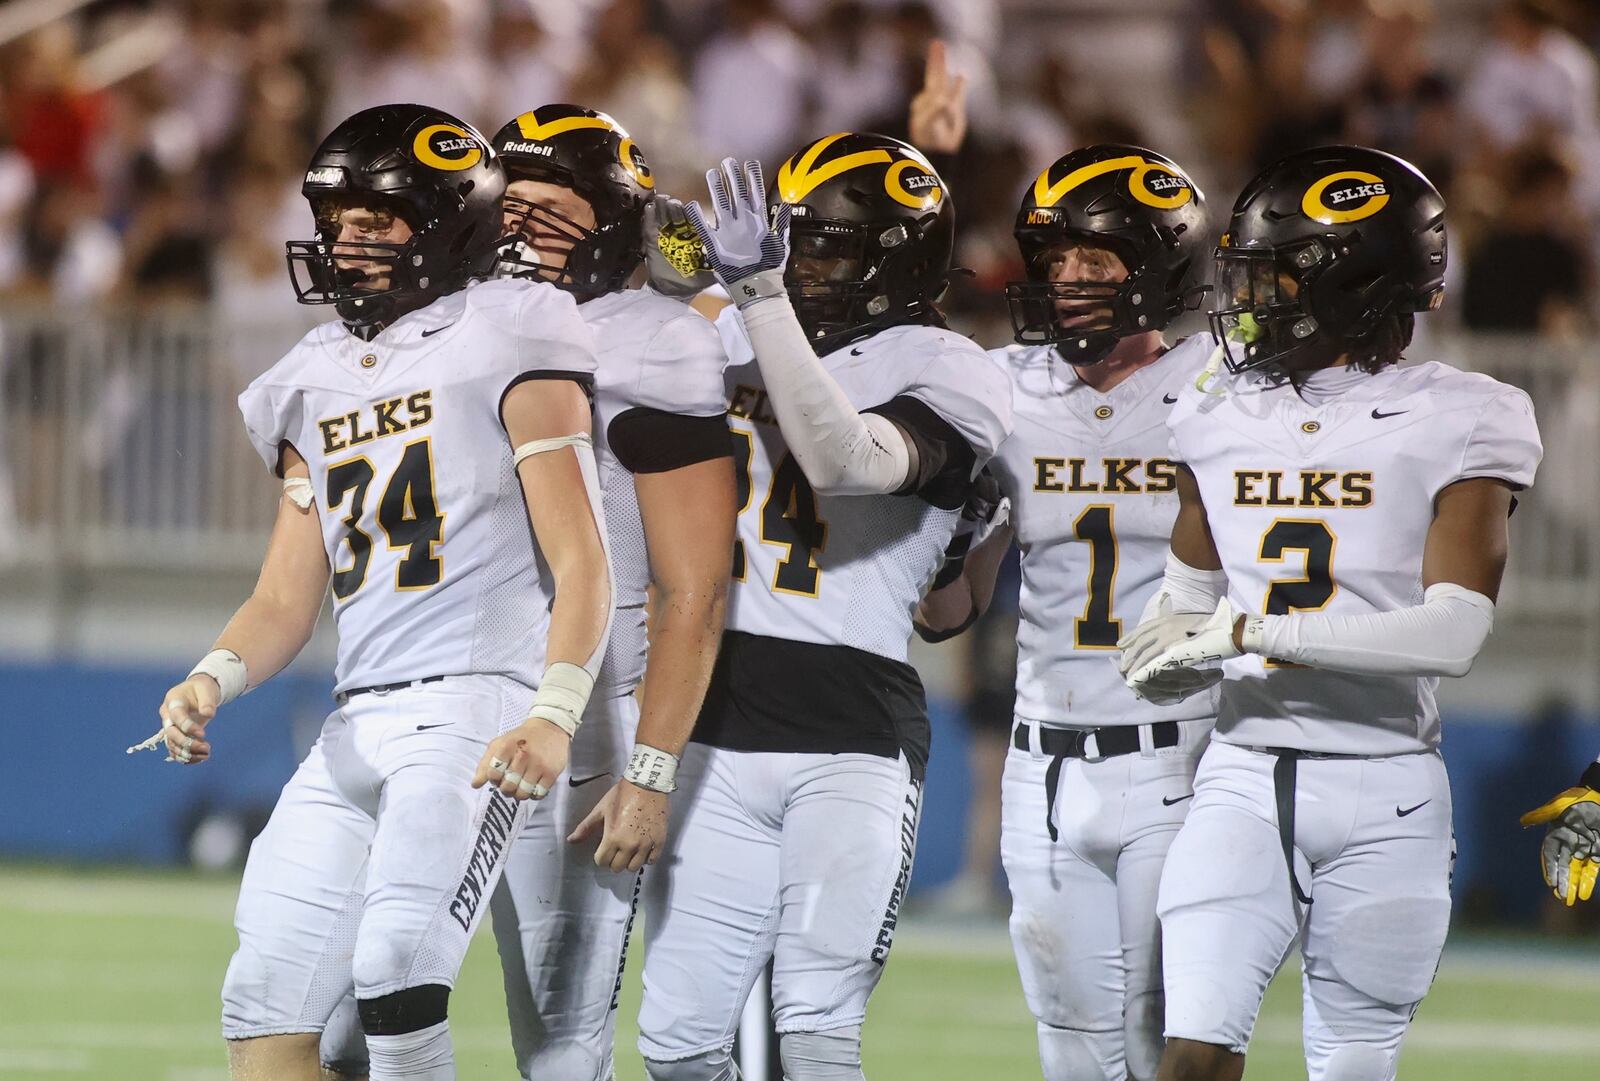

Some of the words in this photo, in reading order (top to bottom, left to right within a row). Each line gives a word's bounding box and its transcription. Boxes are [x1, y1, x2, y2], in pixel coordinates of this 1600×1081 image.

[436, 138, 477, 153] ELKS
[501, 141, 553, 157] Riddell
[905, 175, 939, 189] ELKS
[1150, 175, 1188, 191] ELKS
[1330, 183, 1387, 204] ELKS
[770, 207, 807, 217] Rell
[318, 388, 433, 456] ELKS
[726, 384, 778, 425] EL
[1033, 456, 1176, 494] ELKS
[1233, 470, 1375, 509] ELKS
[326, 435, 447, 602] 34
[1072, 503, 1124, 651] 1
[1257, 517, 1338, 669] 2
[449, 788, 520, 933] CENTERVIL
